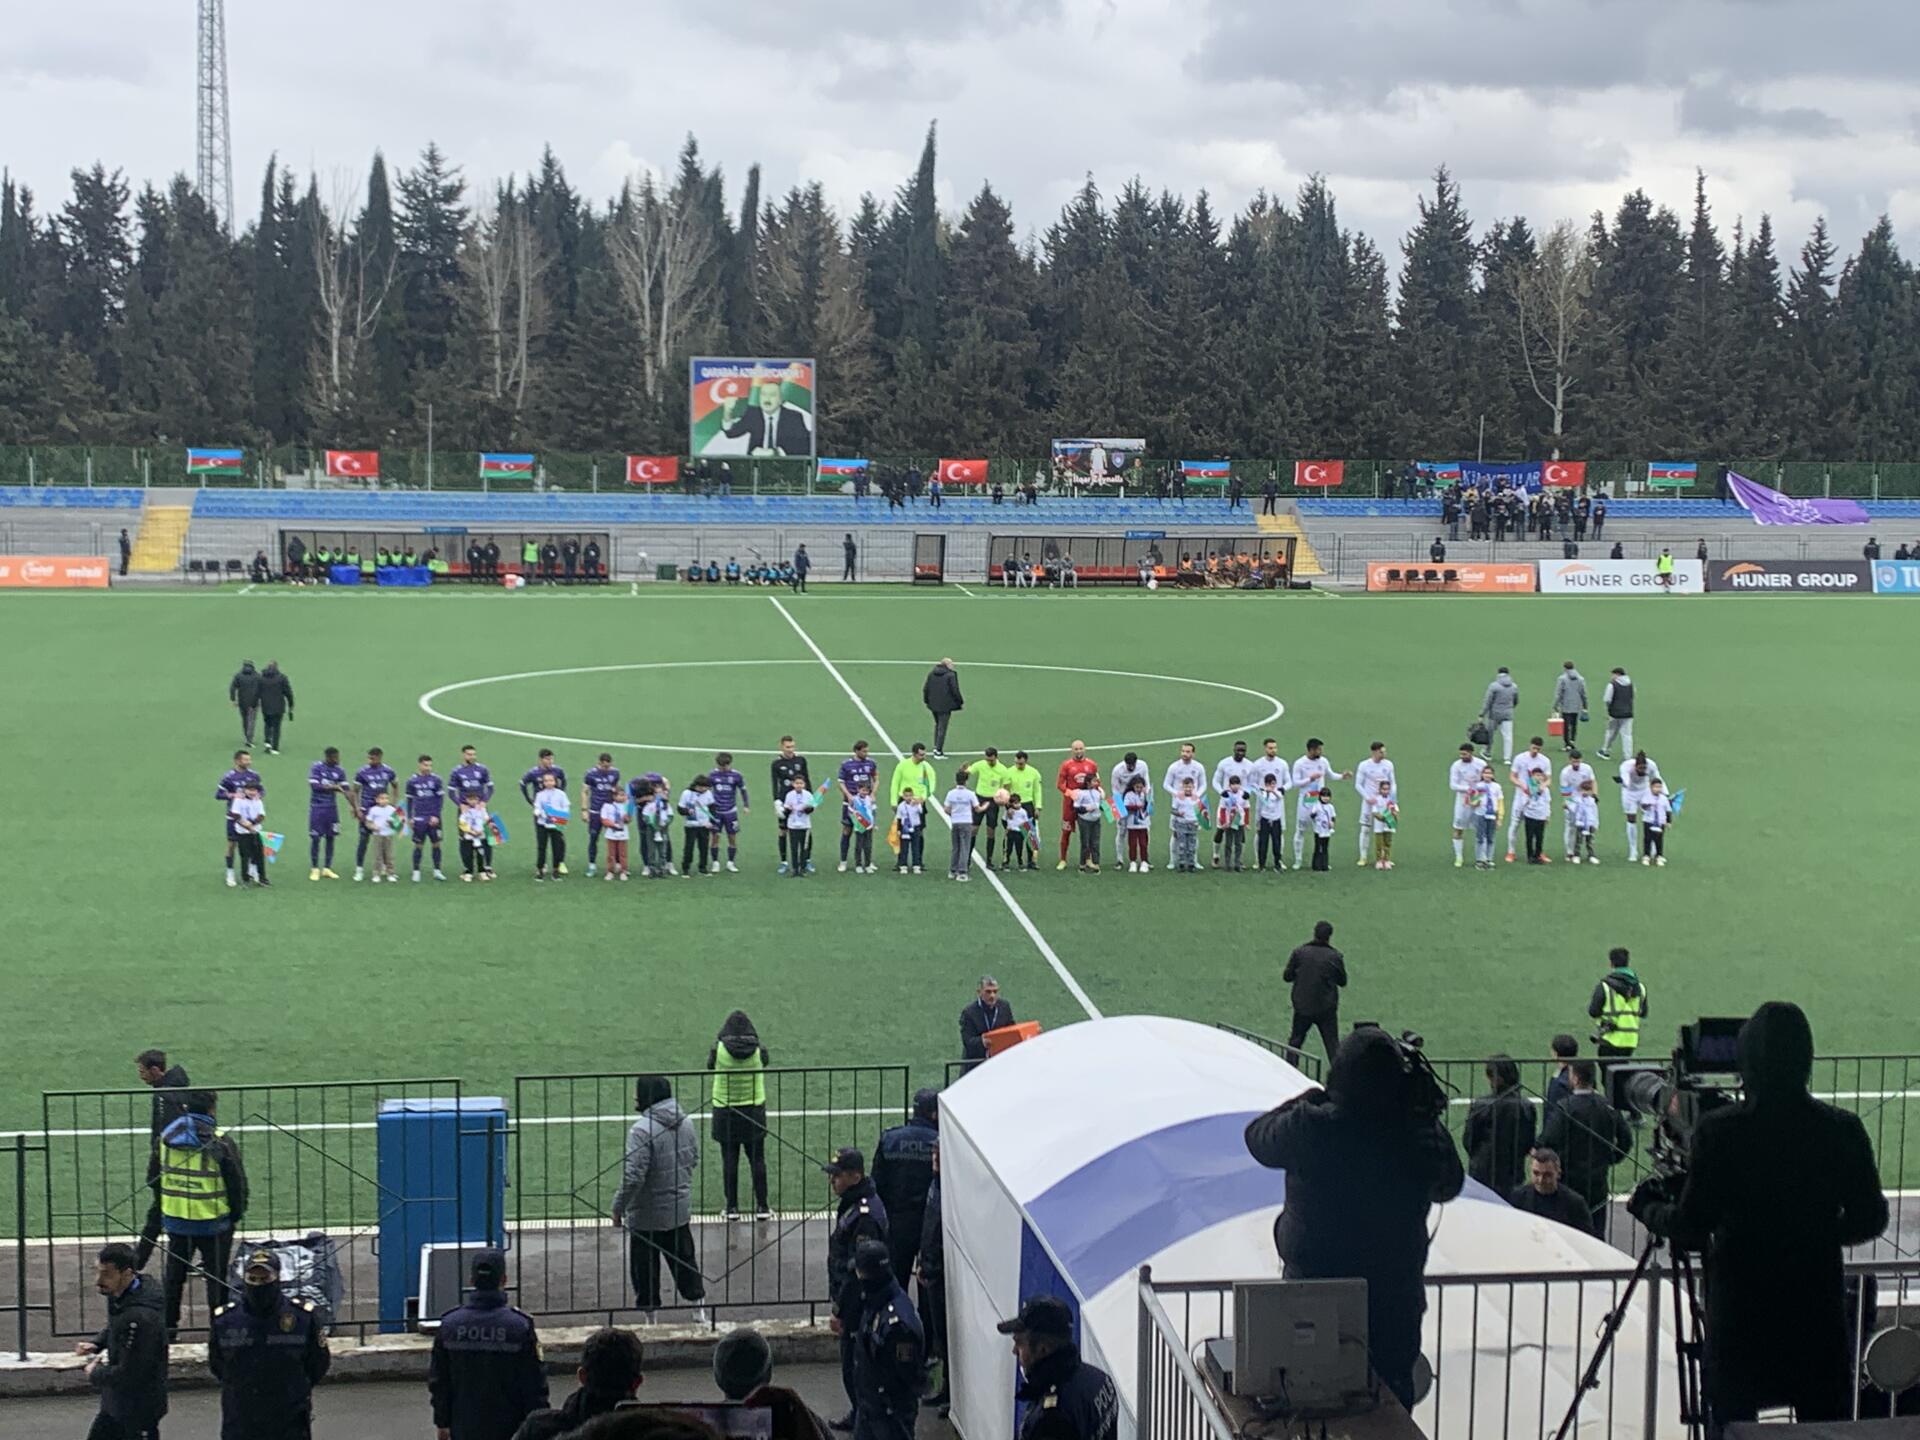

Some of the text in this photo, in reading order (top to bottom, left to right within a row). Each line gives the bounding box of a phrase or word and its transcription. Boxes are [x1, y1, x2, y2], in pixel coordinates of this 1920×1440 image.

[1565, 574, 1689, 586] HUNER GROUP
[1732, 573, 1858, 587] HUNER GROUP
[900, 1140, 930, 1151] POL
[457, 1325, 507, 1341] POLIS
